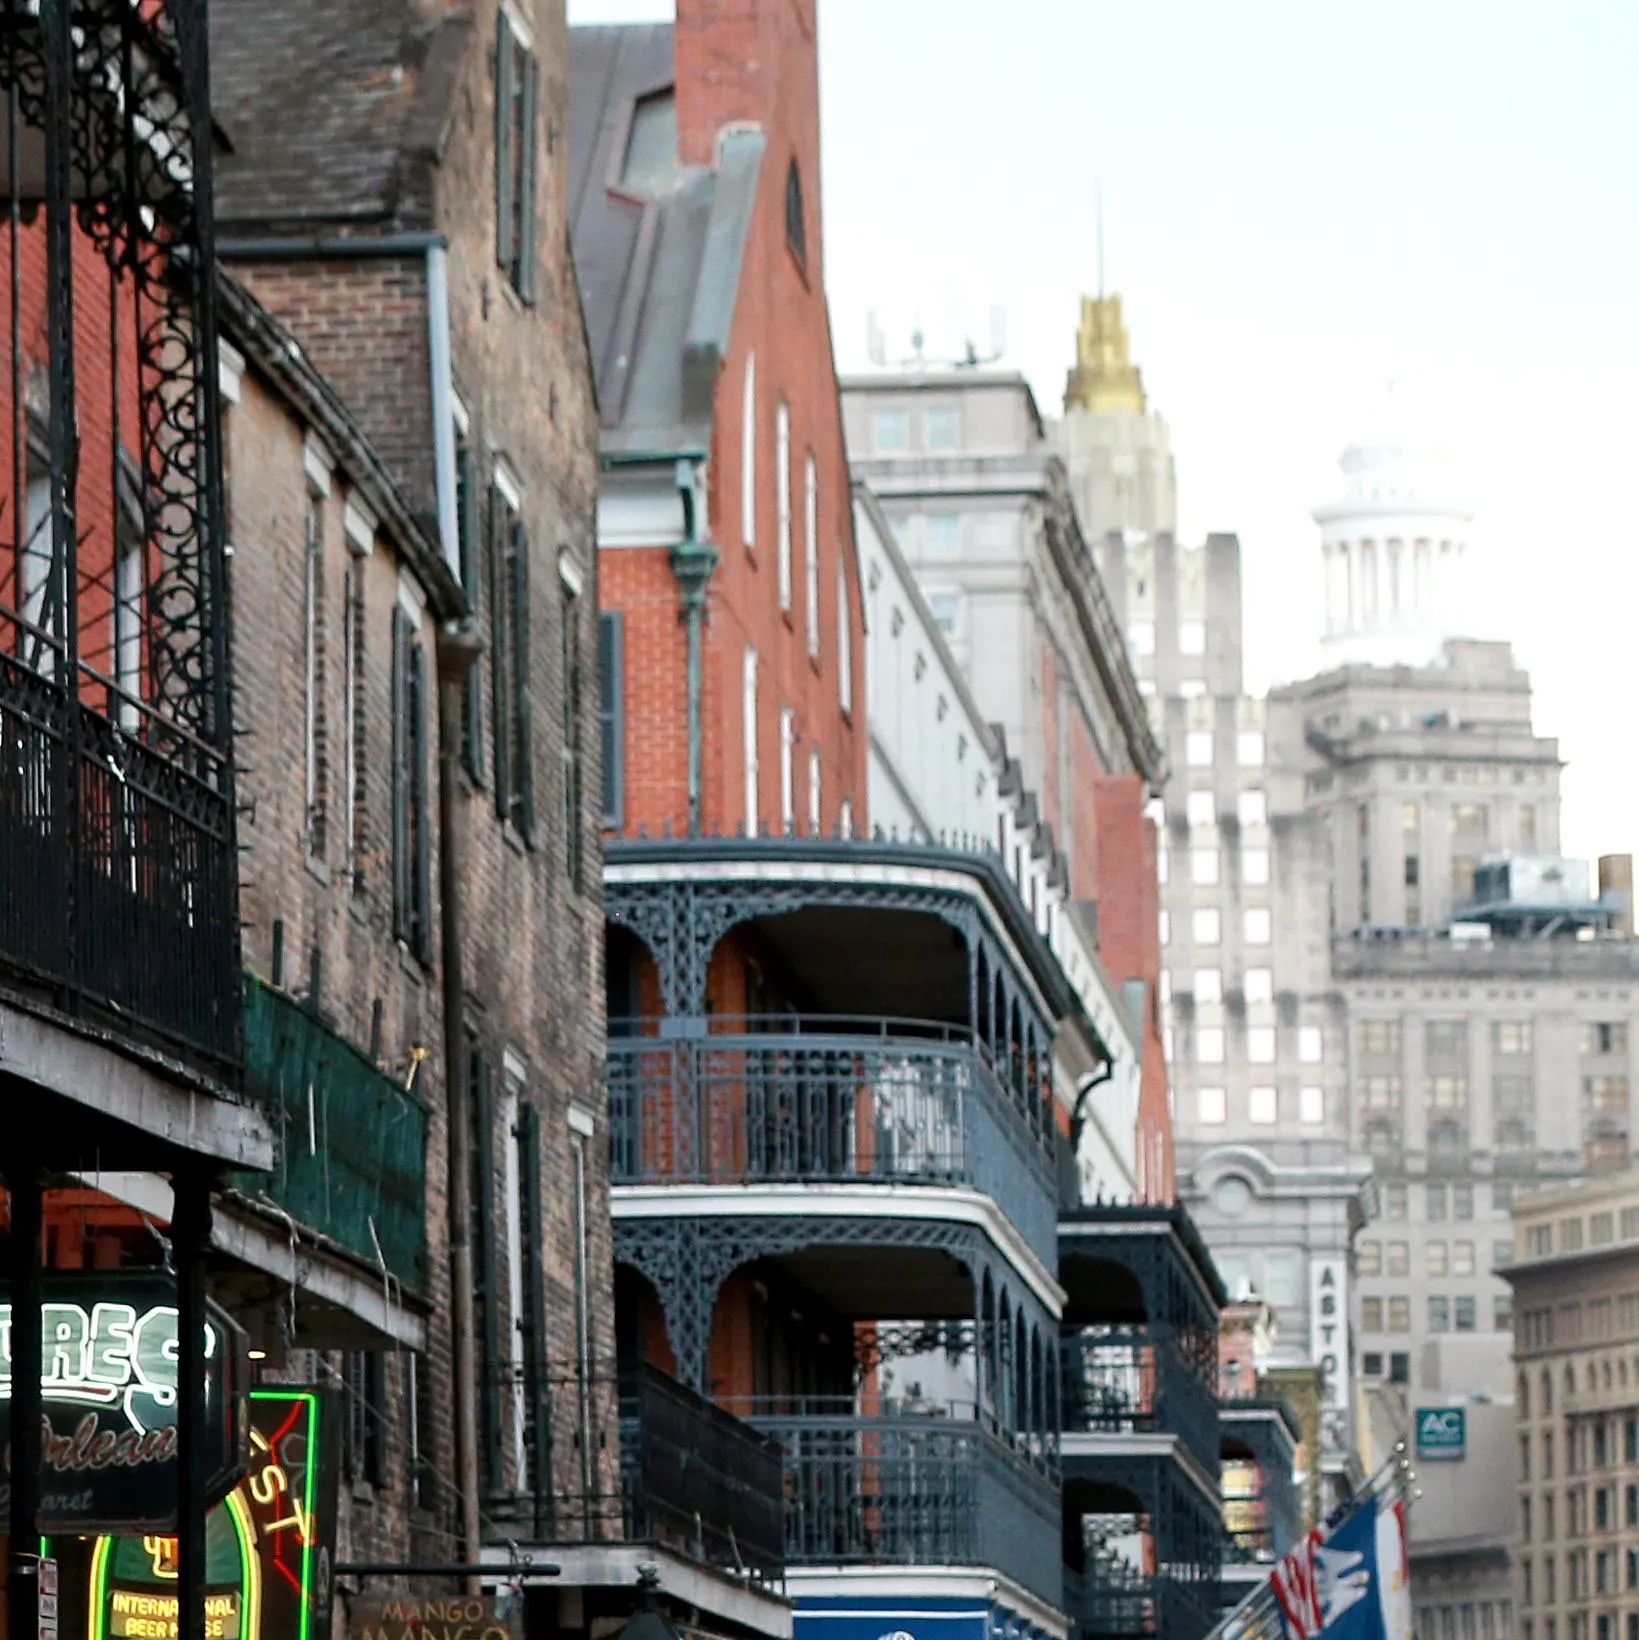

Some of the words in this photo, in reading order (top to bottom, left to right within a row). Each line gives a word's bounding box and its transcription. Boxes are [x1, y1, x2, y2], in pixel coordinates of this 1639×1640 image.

[1421, 1412, 1461, 1436] AC
[112, 1593, 236, 1617] INTERNANAL
[382, 1599, 484, 1623] MANGO
[125, 1619, 167, 1638] BEER
